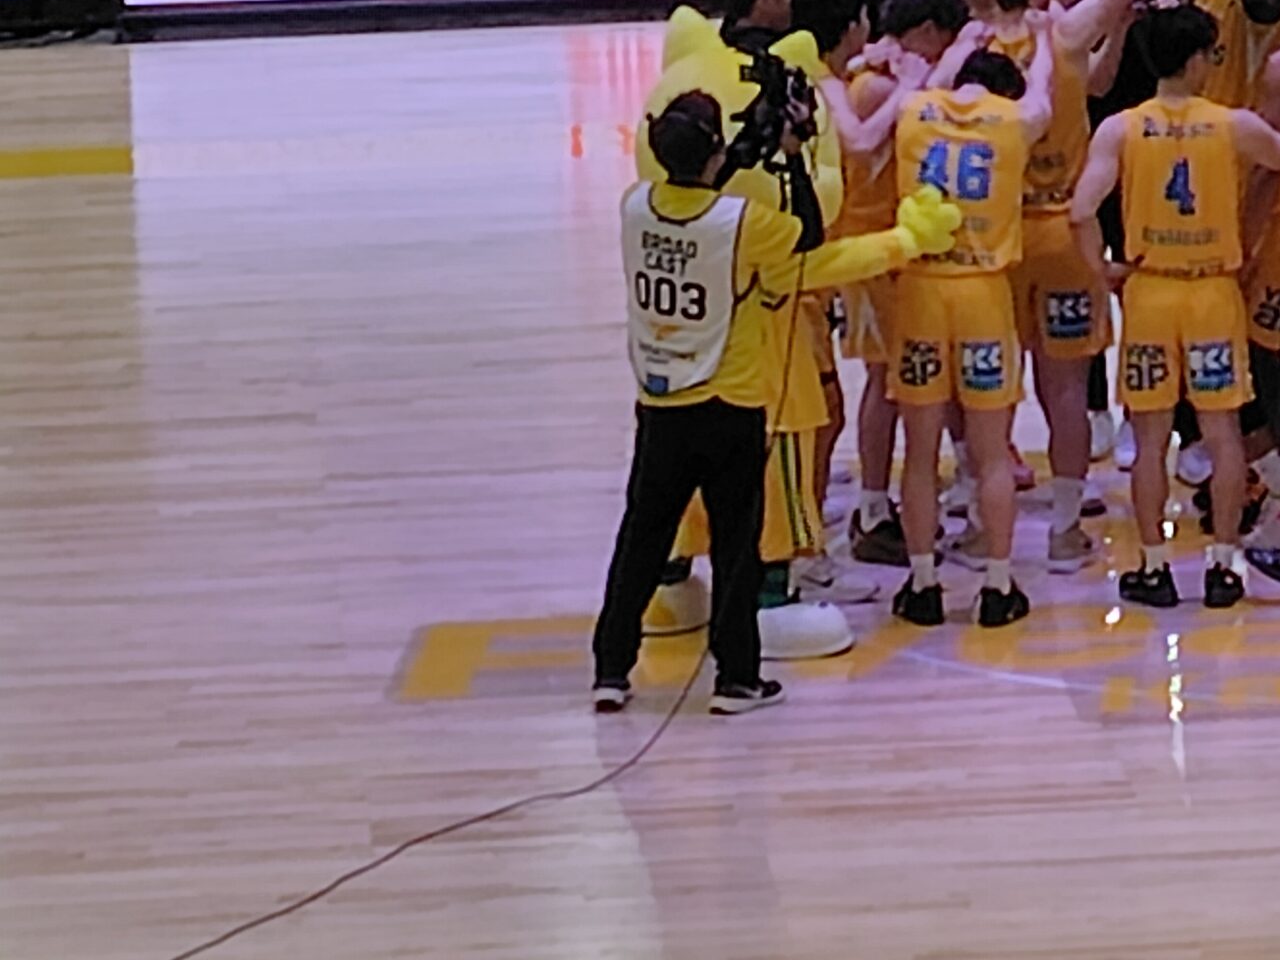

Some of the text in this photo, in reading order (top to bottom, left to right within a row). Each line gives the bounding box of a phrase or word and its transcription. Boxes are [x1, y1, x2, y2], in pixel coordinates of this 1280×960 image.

[918, 140, 995, 200] 46
[1164, 157, 1196, 216] 4
[634, 269, 708, 321] 003
